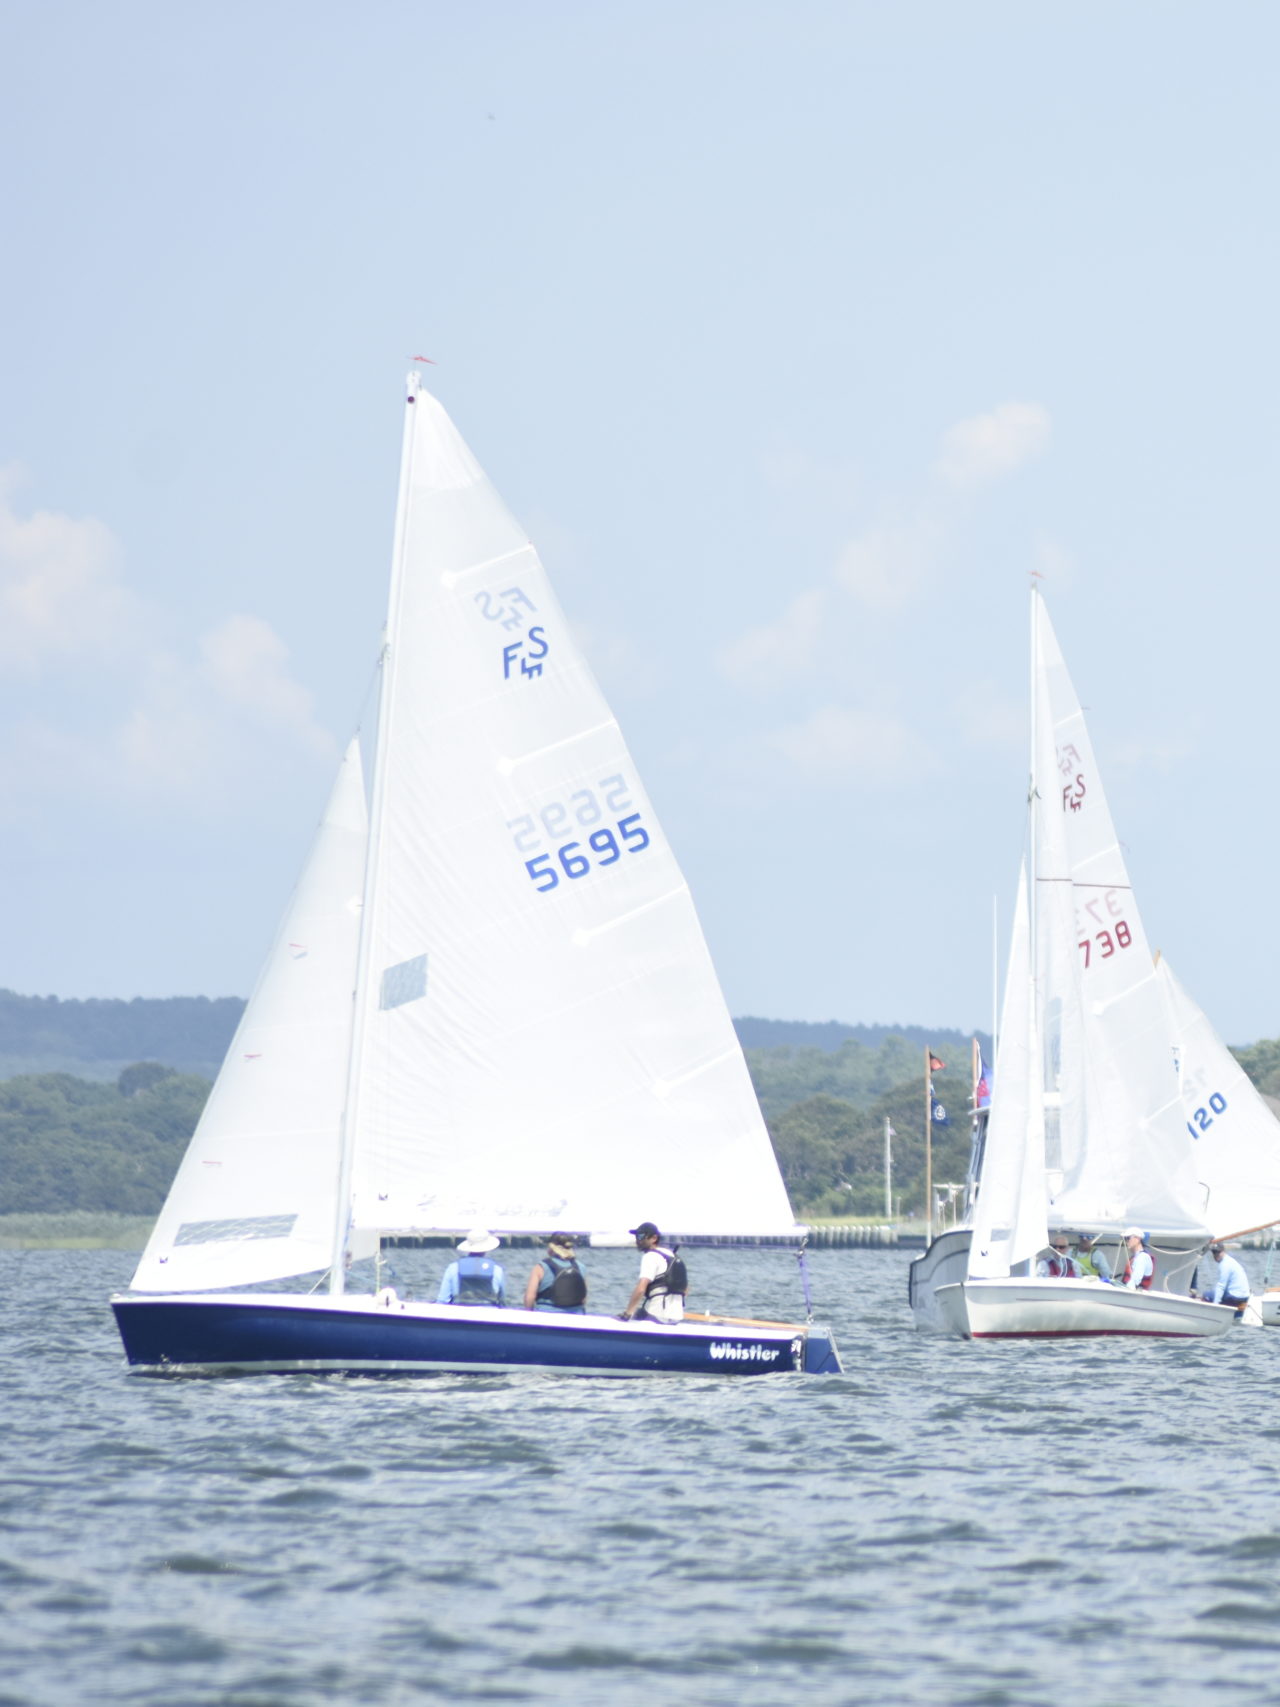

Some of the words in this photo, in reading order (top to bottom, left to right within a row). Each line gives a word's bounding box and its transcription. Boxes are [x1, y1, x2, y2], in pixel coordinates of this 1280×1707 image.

[524, 812, 650, 893] 5695
[1078, 920, 1132, 969] 738
[709, 1342, 780, 1362] Whistler
